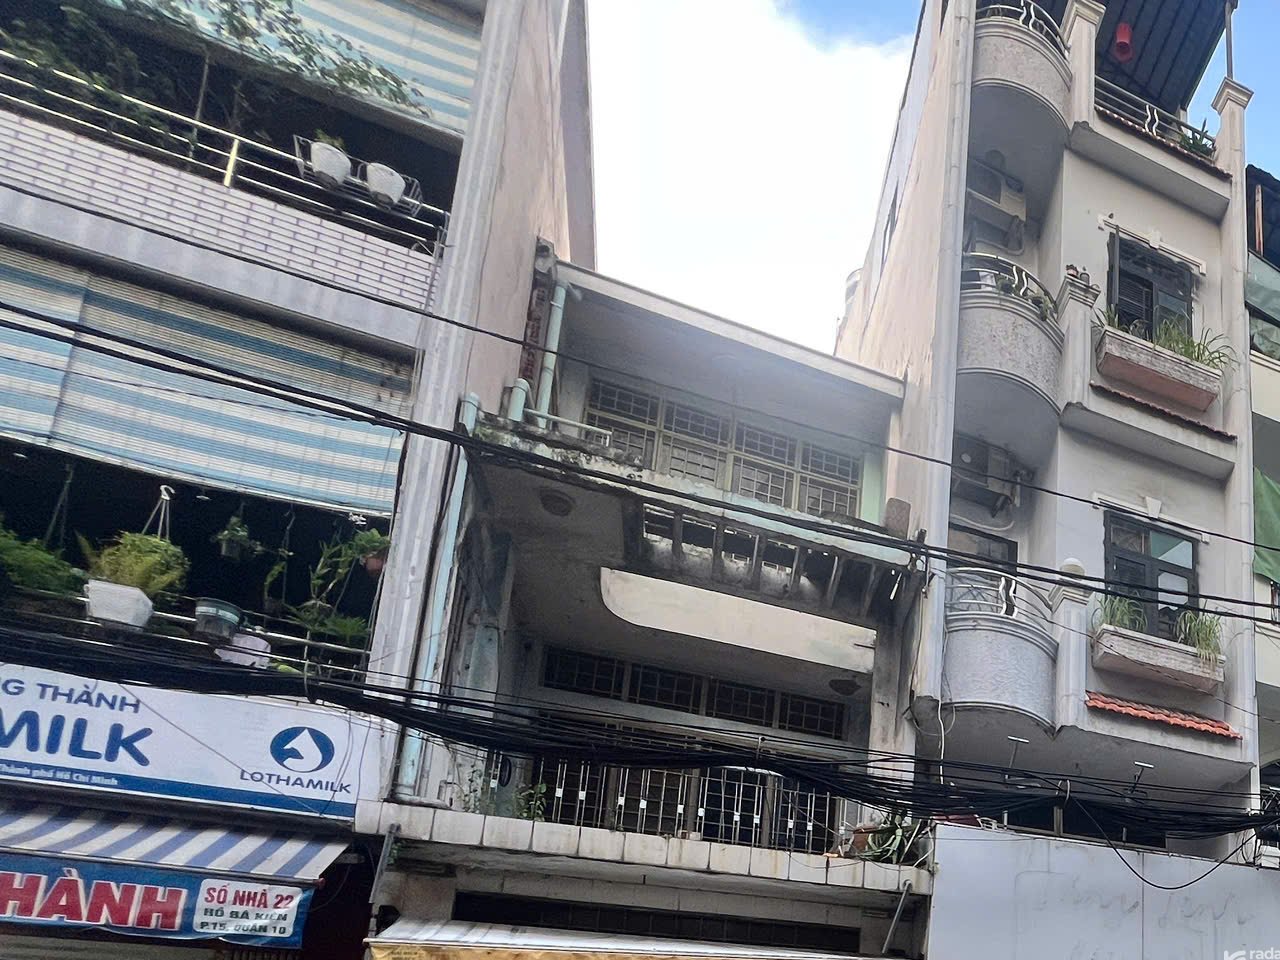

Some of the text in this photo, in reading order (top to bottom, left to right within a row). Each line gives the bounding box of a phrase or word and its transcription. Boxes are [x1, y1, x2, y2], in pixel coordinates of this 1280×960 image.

[36, 682, 141, 713] THÀNH
[0, 707, 153, 767] MILK
[240, 769, 352, 793] LOTHAMILK
[0, 867, 188, 931] HÀNH
[204, 883, 294, 909] SỐ NHÀ 22
[272, 925, 287, 935] 10
